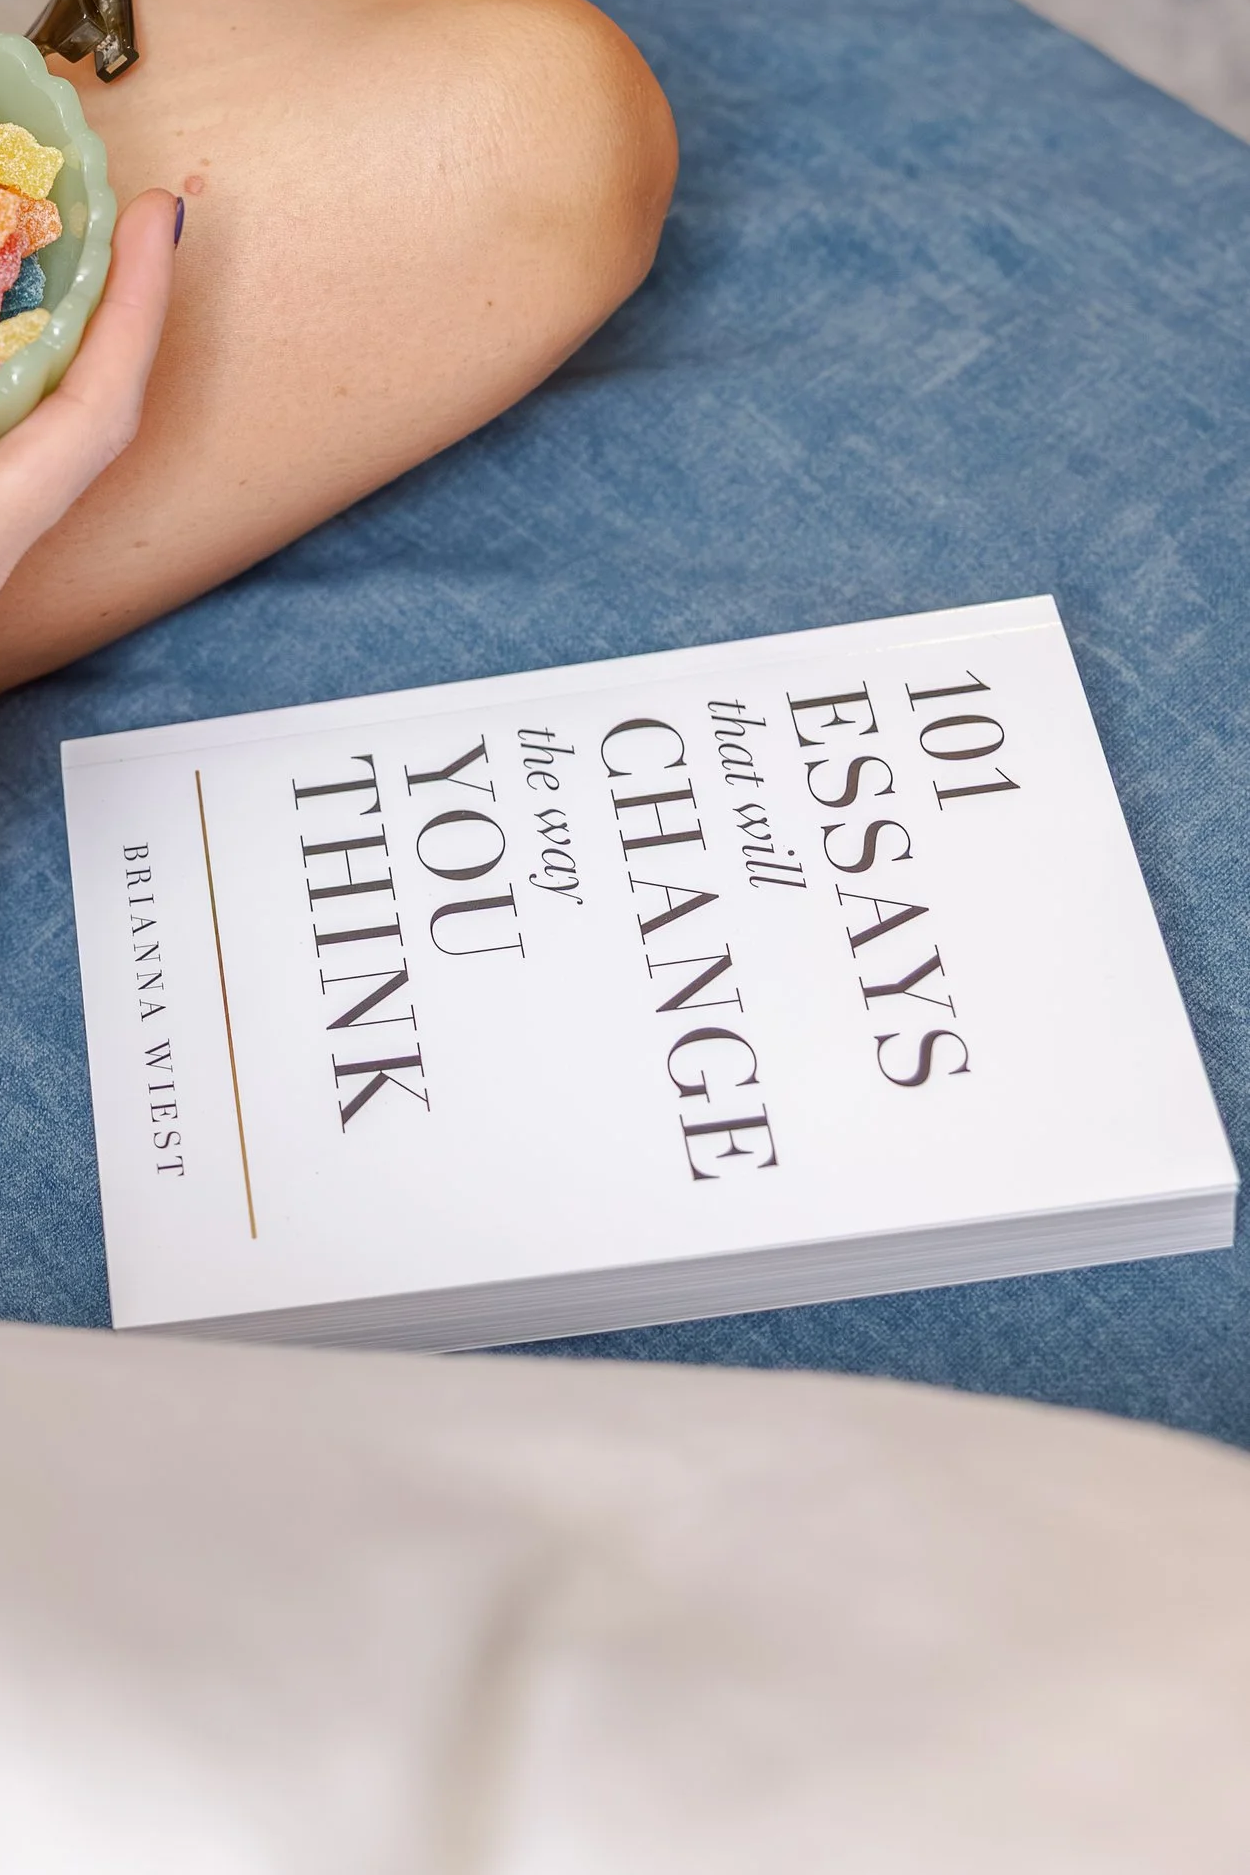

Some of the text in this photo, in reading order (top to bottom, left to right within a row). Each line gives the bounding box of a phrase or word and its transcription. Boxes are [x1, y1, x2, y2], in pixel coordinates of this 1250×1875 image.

[404, 734, 525, 958] YOU
[518, 728, 583, 905] the way
[708, 700, 807, 888] that will
[905, 671, 1020, 811] 101
[123, 843, 184, 1176] BRIANNA WIEST
[292, 754, 430, 1133] THINK
[601, 718, 777, 1180] CHANGE
[786, 681, 970, 1087] ESSAYS
